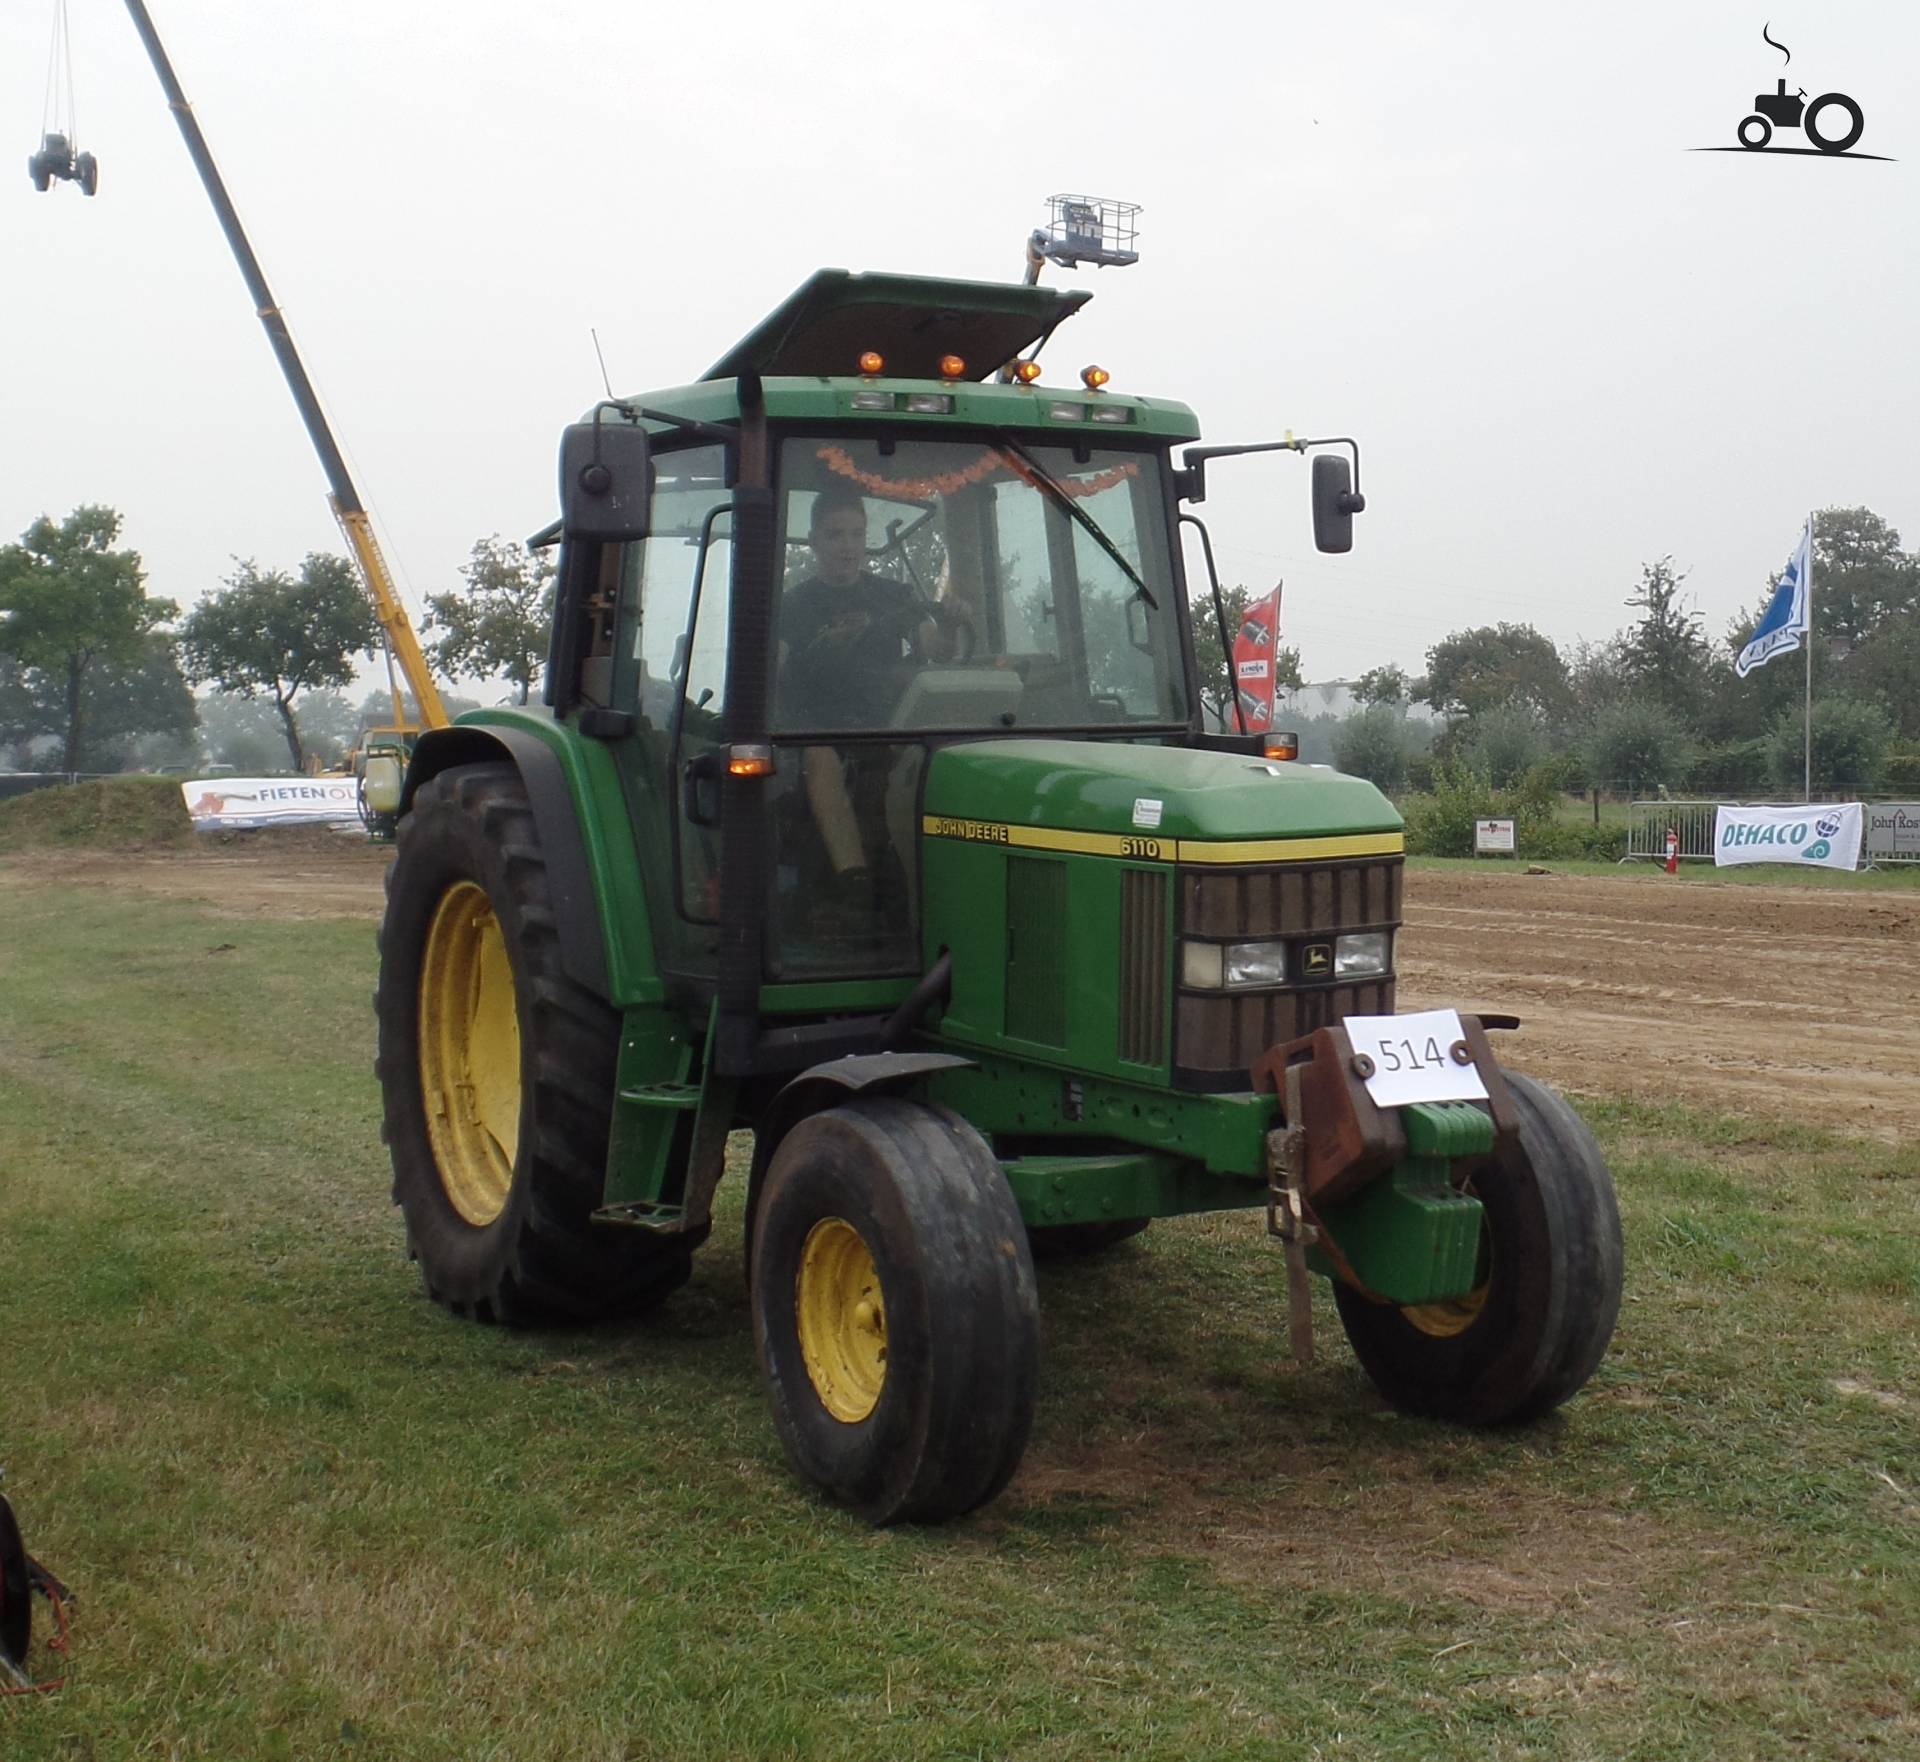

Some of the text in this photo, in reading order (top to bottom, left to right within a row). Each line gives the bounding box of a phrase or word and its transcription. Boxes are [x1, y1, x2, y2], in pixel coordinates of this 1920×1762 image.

[259, 787, 357, 801] FIETEN OL
[935, 819, 1008, 843] JOHN DEERE
[1871, 815, 1920, 831] John Kos
[1721, 822, 1808, 848] DEHACO
[1121, 837, 1160, 858] 6110
[1378, 1036, 1446, 1072] 514
